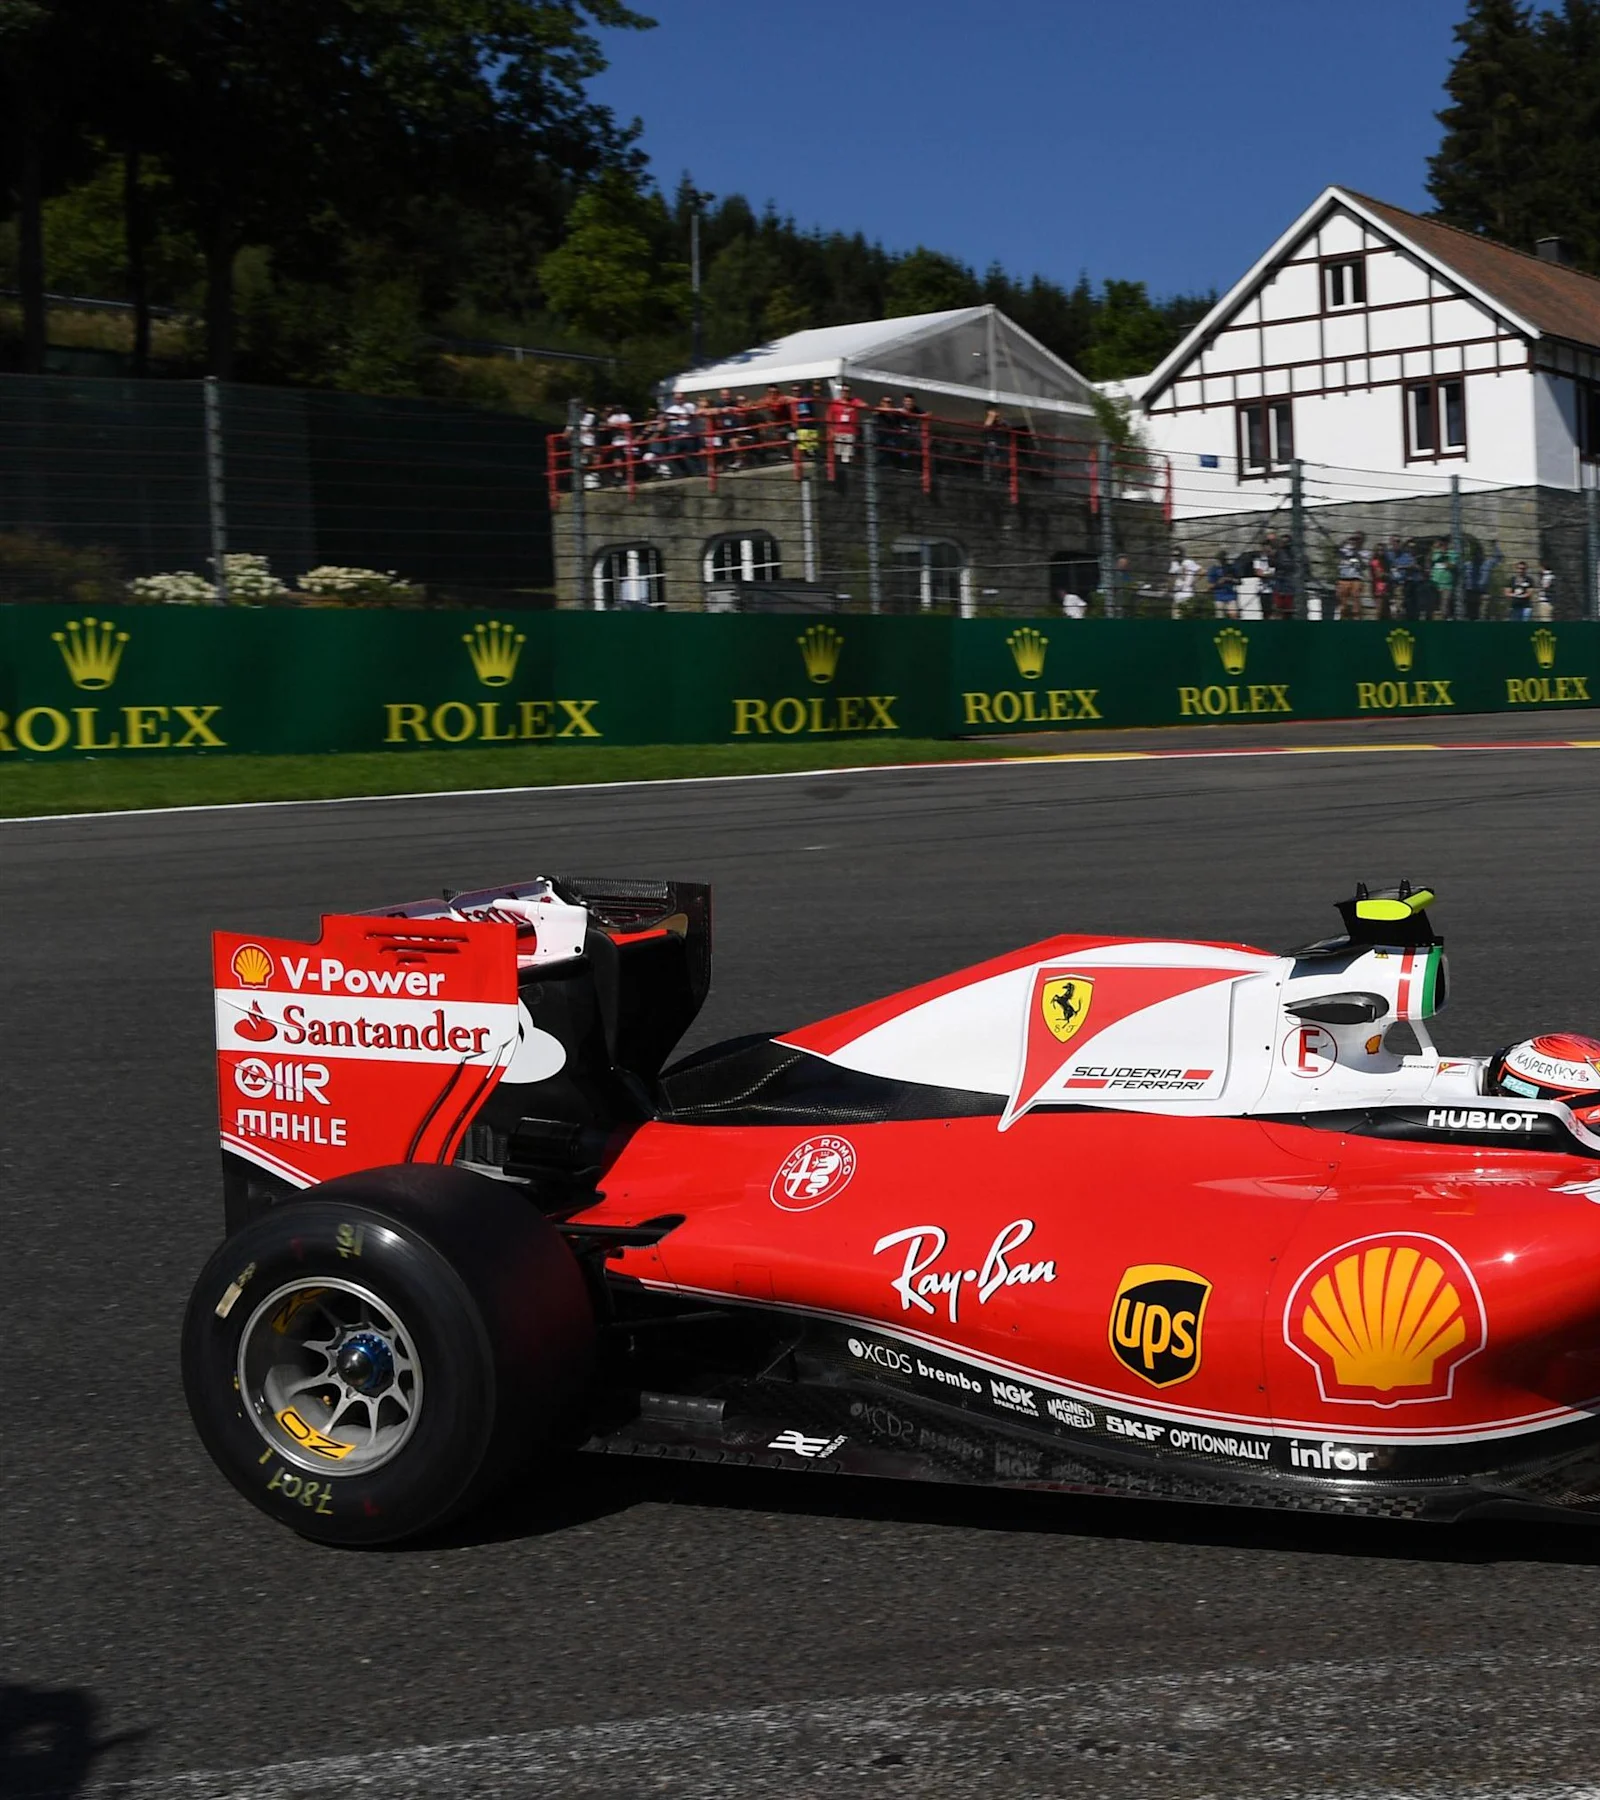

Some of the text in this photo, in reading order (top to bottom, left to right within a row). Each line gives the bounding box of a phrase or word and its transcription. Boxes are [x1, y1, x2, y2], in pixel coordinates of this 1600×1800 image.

[963, 688, 1102, 726] ROLEX
[1178, 683, 1292, 717] ROLEX
[1357, 679, 1454, 710] ROLEX
[1506, 676, 1591, 704] ROLEX
[0, 704, 224, 753] OLEX
[385, 698, 601, 744] ROLEX
[733, 694, 898, 736] ROLEX
[281, 957, 445, 997] V-Power
[283, 1005, 490, 1053] Santander
[1072, 1066, 1182, 1079] SCUDERIA
[1515, 1052, 1578, 1080] KASPERSKY
[1108, 1079, 1205, 1091] FERRARI
[237, 1108, 347, 1147] MAHLE
[1427, 1109, 1538, 1132] HUBLOT
[781, 1138, 853, 1178] ALFA ROMEO
[1115, 1298, 1196, 1369] ups
[916, 1359, 982, 1393] brembo
[990, 1379, 1036, 1410] NGK
[1106, 1414, 1165, 1442] SKF
[817, 1434, 849, 1458] HUBLOT
[1290, 1439, 1375, 1471] infor
